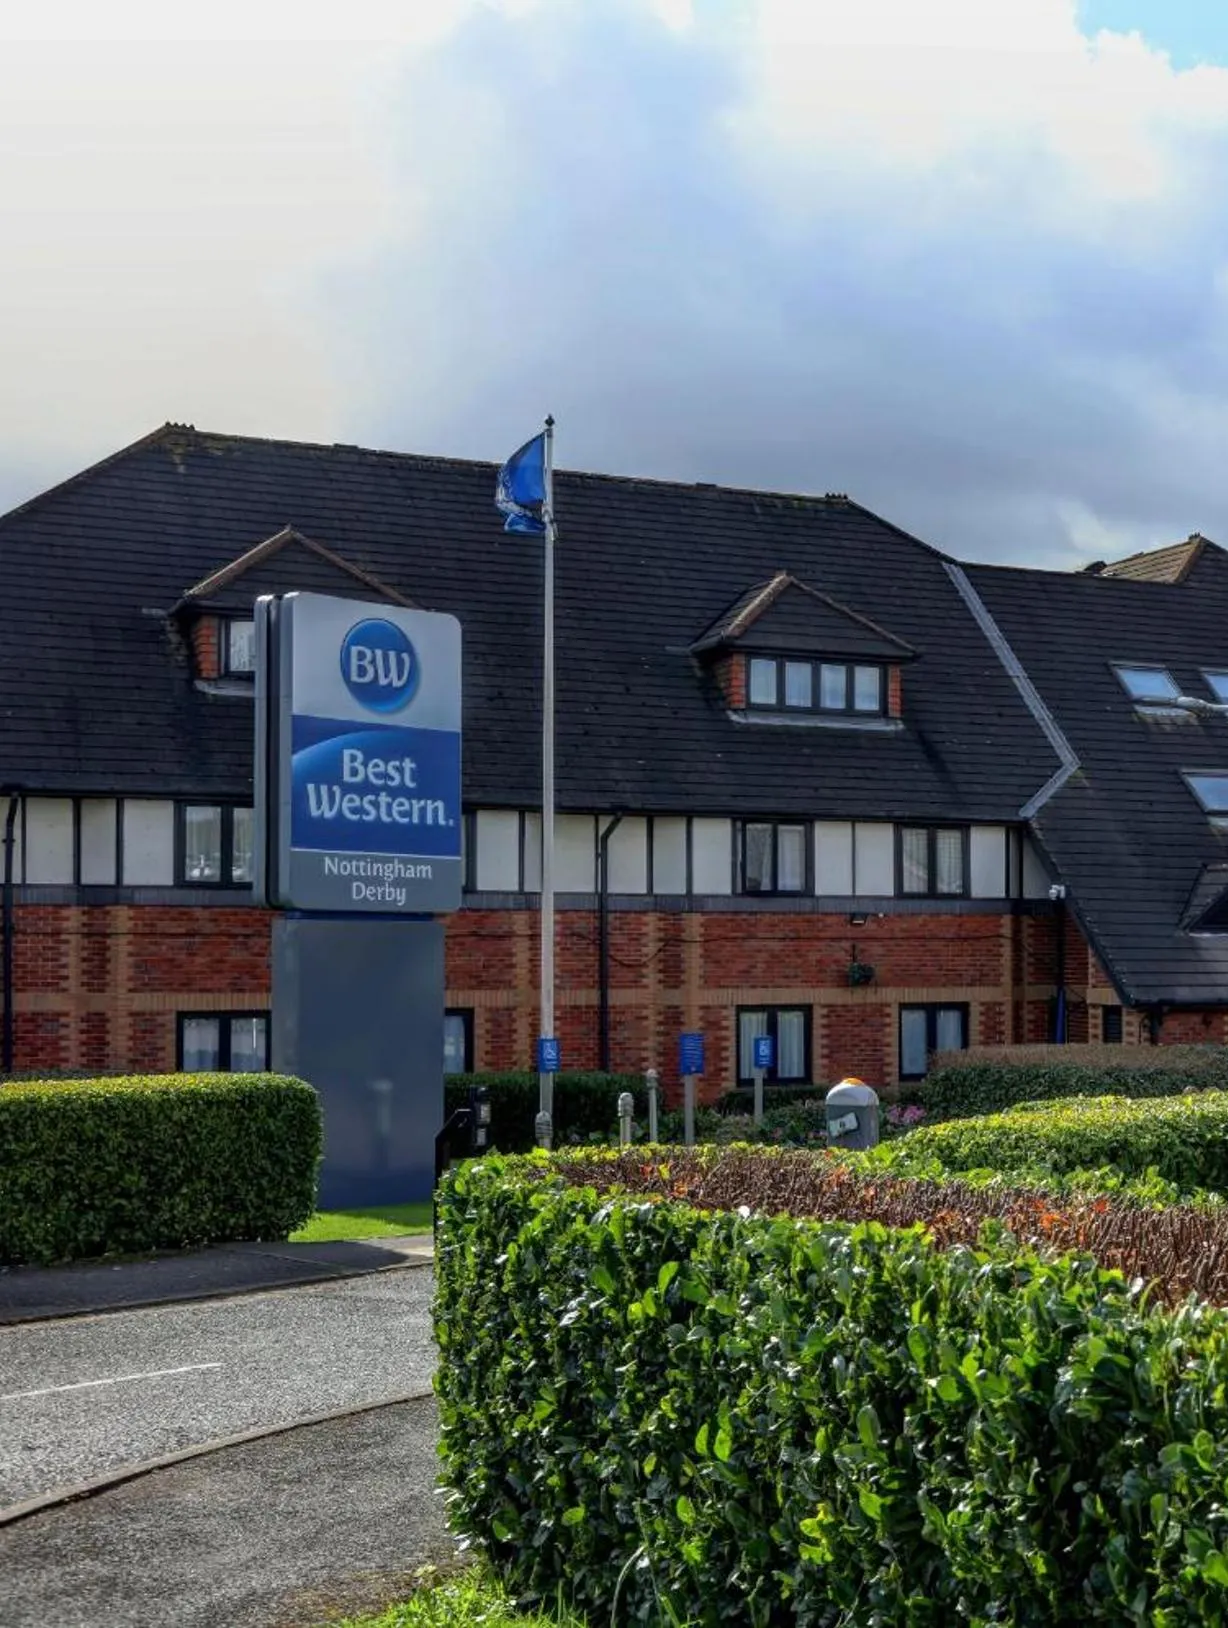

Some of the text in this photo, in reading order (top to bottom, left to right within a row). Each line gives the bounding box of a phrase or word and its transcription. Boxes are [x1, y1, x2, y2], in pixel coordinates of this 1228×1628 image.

[350, 645, 411, 688] BW
[342, 749, 417, 789] Best
[324, 856, 433, 880] Nottingham
[352, 882, 406, 906] Derby
